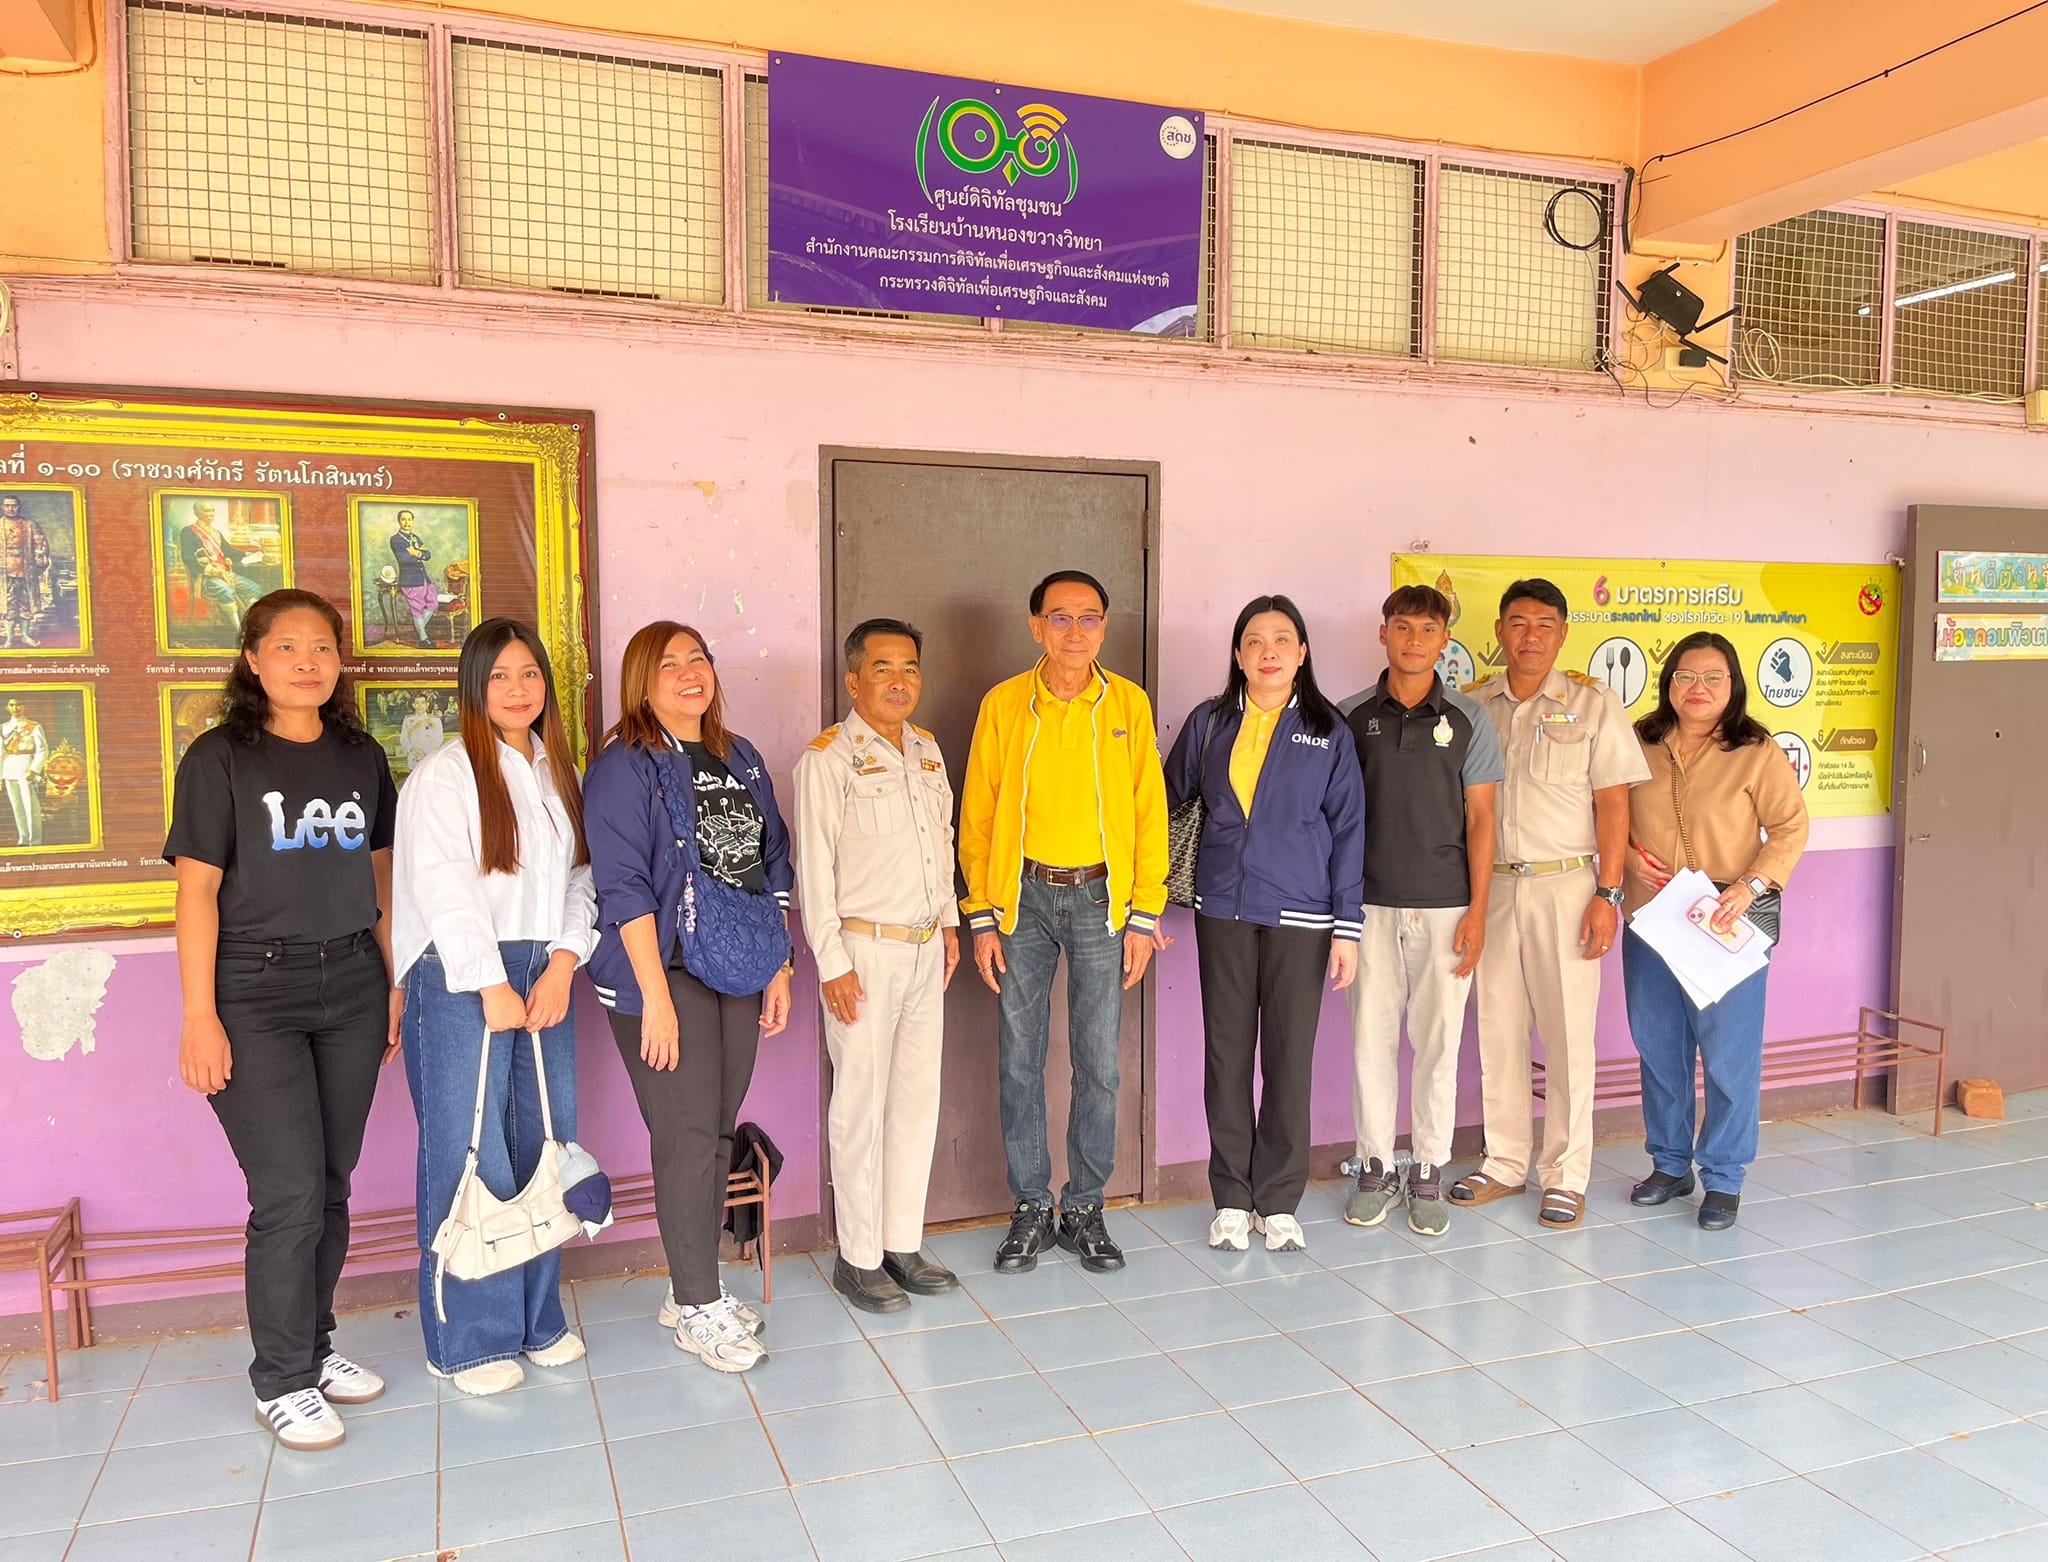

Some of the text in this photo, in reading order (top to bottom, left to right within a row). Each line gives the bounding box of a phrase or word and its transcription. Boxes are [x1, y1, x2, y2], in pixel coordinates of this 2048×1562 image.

[933, 185, 1063, 218] ศูนย์ดิจิทัลชุมชน
[888, 209, 1103, 252] โรงเรียนบ้านหนองขวางวิทยา
[805, 236, 1170, 289] สำนักงานคณะกรรมการดิจิทัลเพื่อเศรษฐกิจและสังคมแห่งชาติ
[879, 272, 1108, 309] กระทรวงดิจิทัลเพื่อเศรษฐกิจและสังคม
[112, 457, 243, 482] (ราชวงศ์จักรี
[255, 460, 393, 490] รัตนโกสินทร์)
[1593, 575, 1743, 606] 6 มาตรการเสริม
[1655, 638, 1662, 652] 2
[1820, 641, 1827, 655] 3
[1764, 684, 1803, 699] ไทยชนะ
[1291, 733, 1330, 750] ONDE
[1818, 729, 1825, 743] 6
[262, 790, 366, 851] Lee
